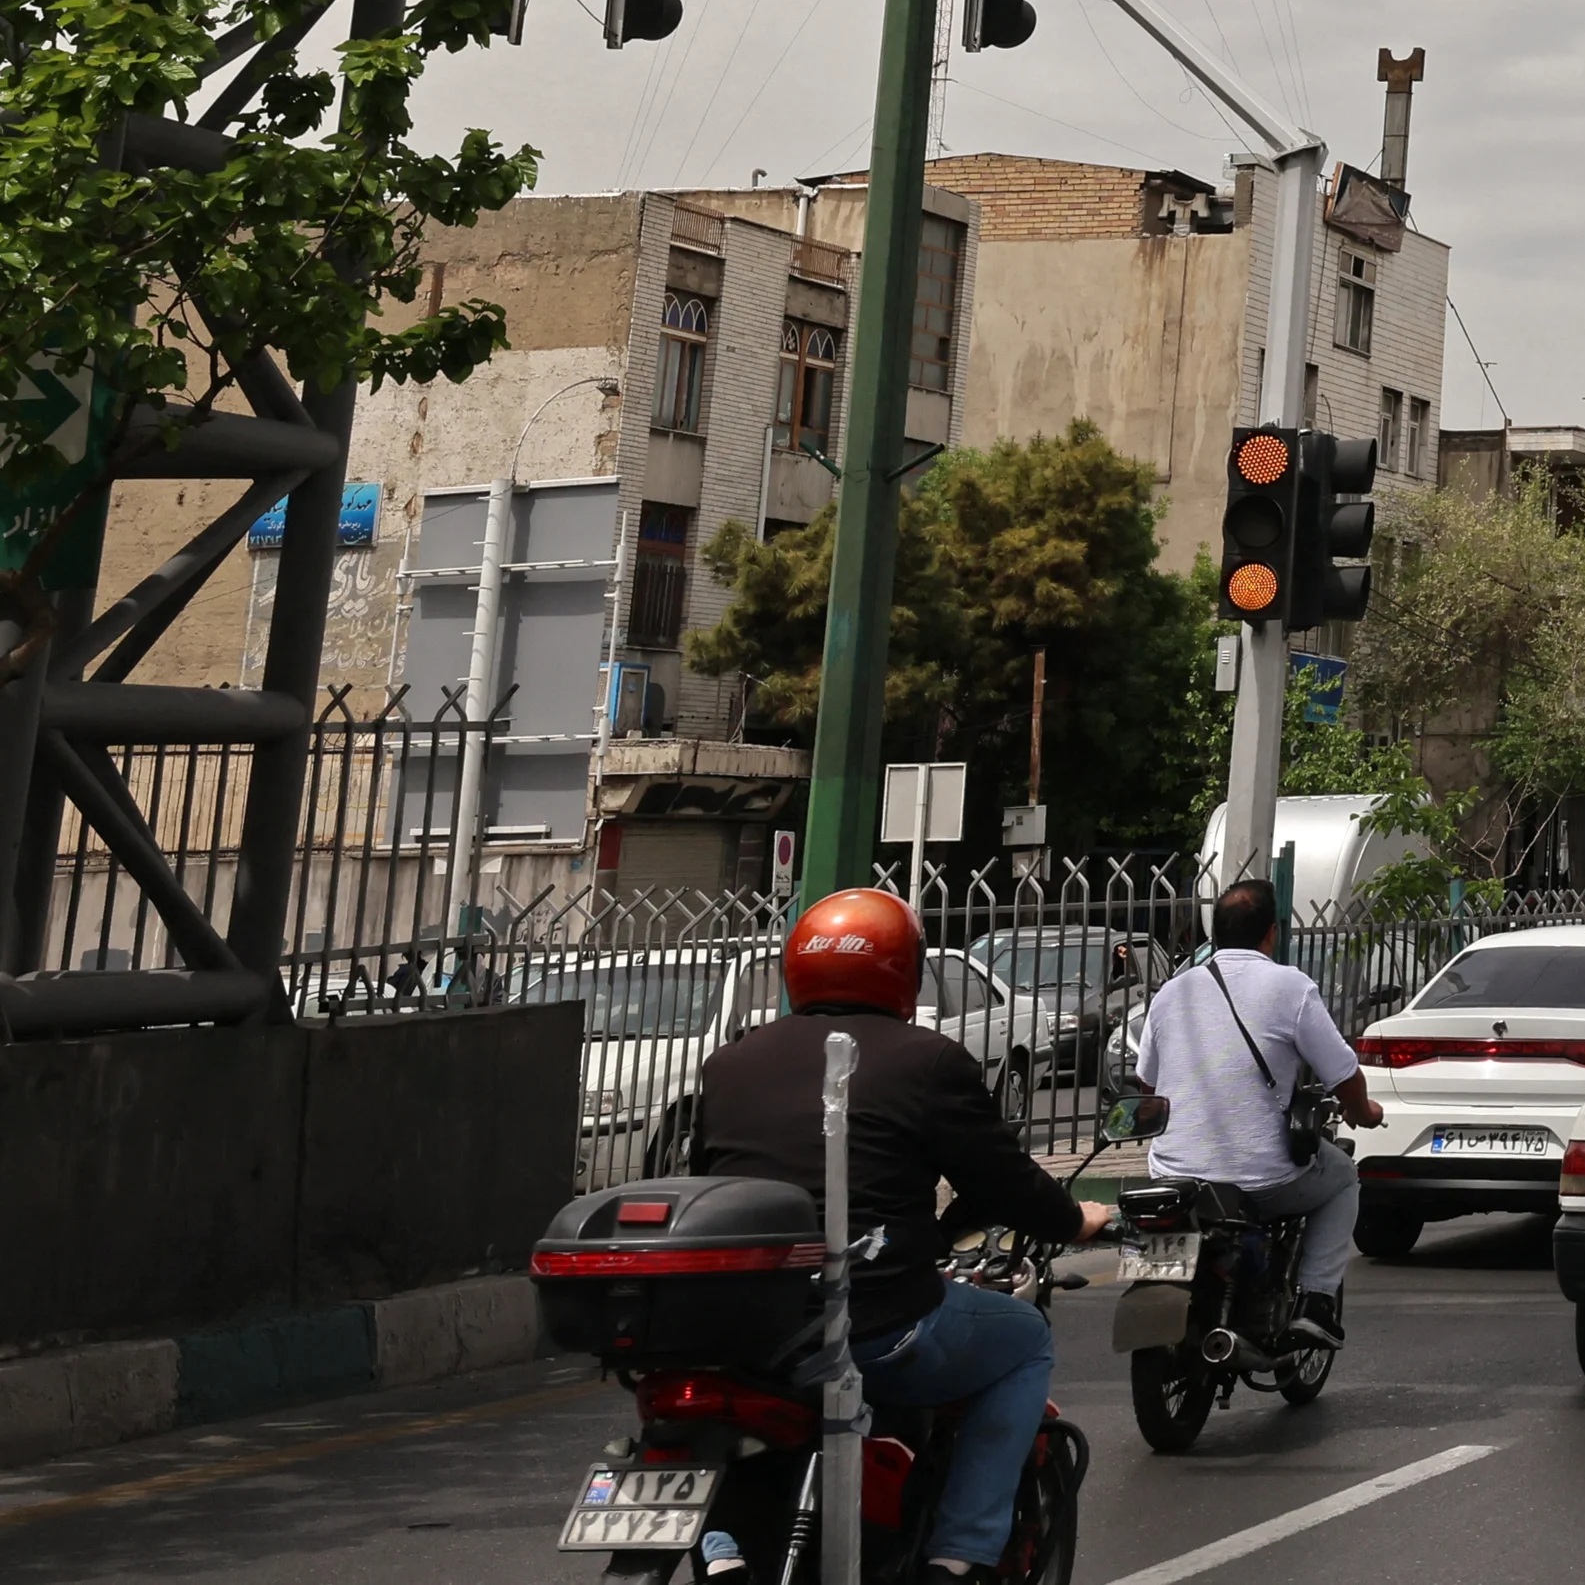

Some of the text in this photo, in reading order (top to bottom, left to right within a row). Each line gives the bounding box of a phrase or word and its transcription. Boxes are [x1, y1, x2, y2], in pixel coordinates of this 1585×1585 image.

[1444, 1132, 1544, 1152] ۶۱ ص ۳۹۴ ۷۵
[633, 1472, 695, 1502] ۱۳۵
